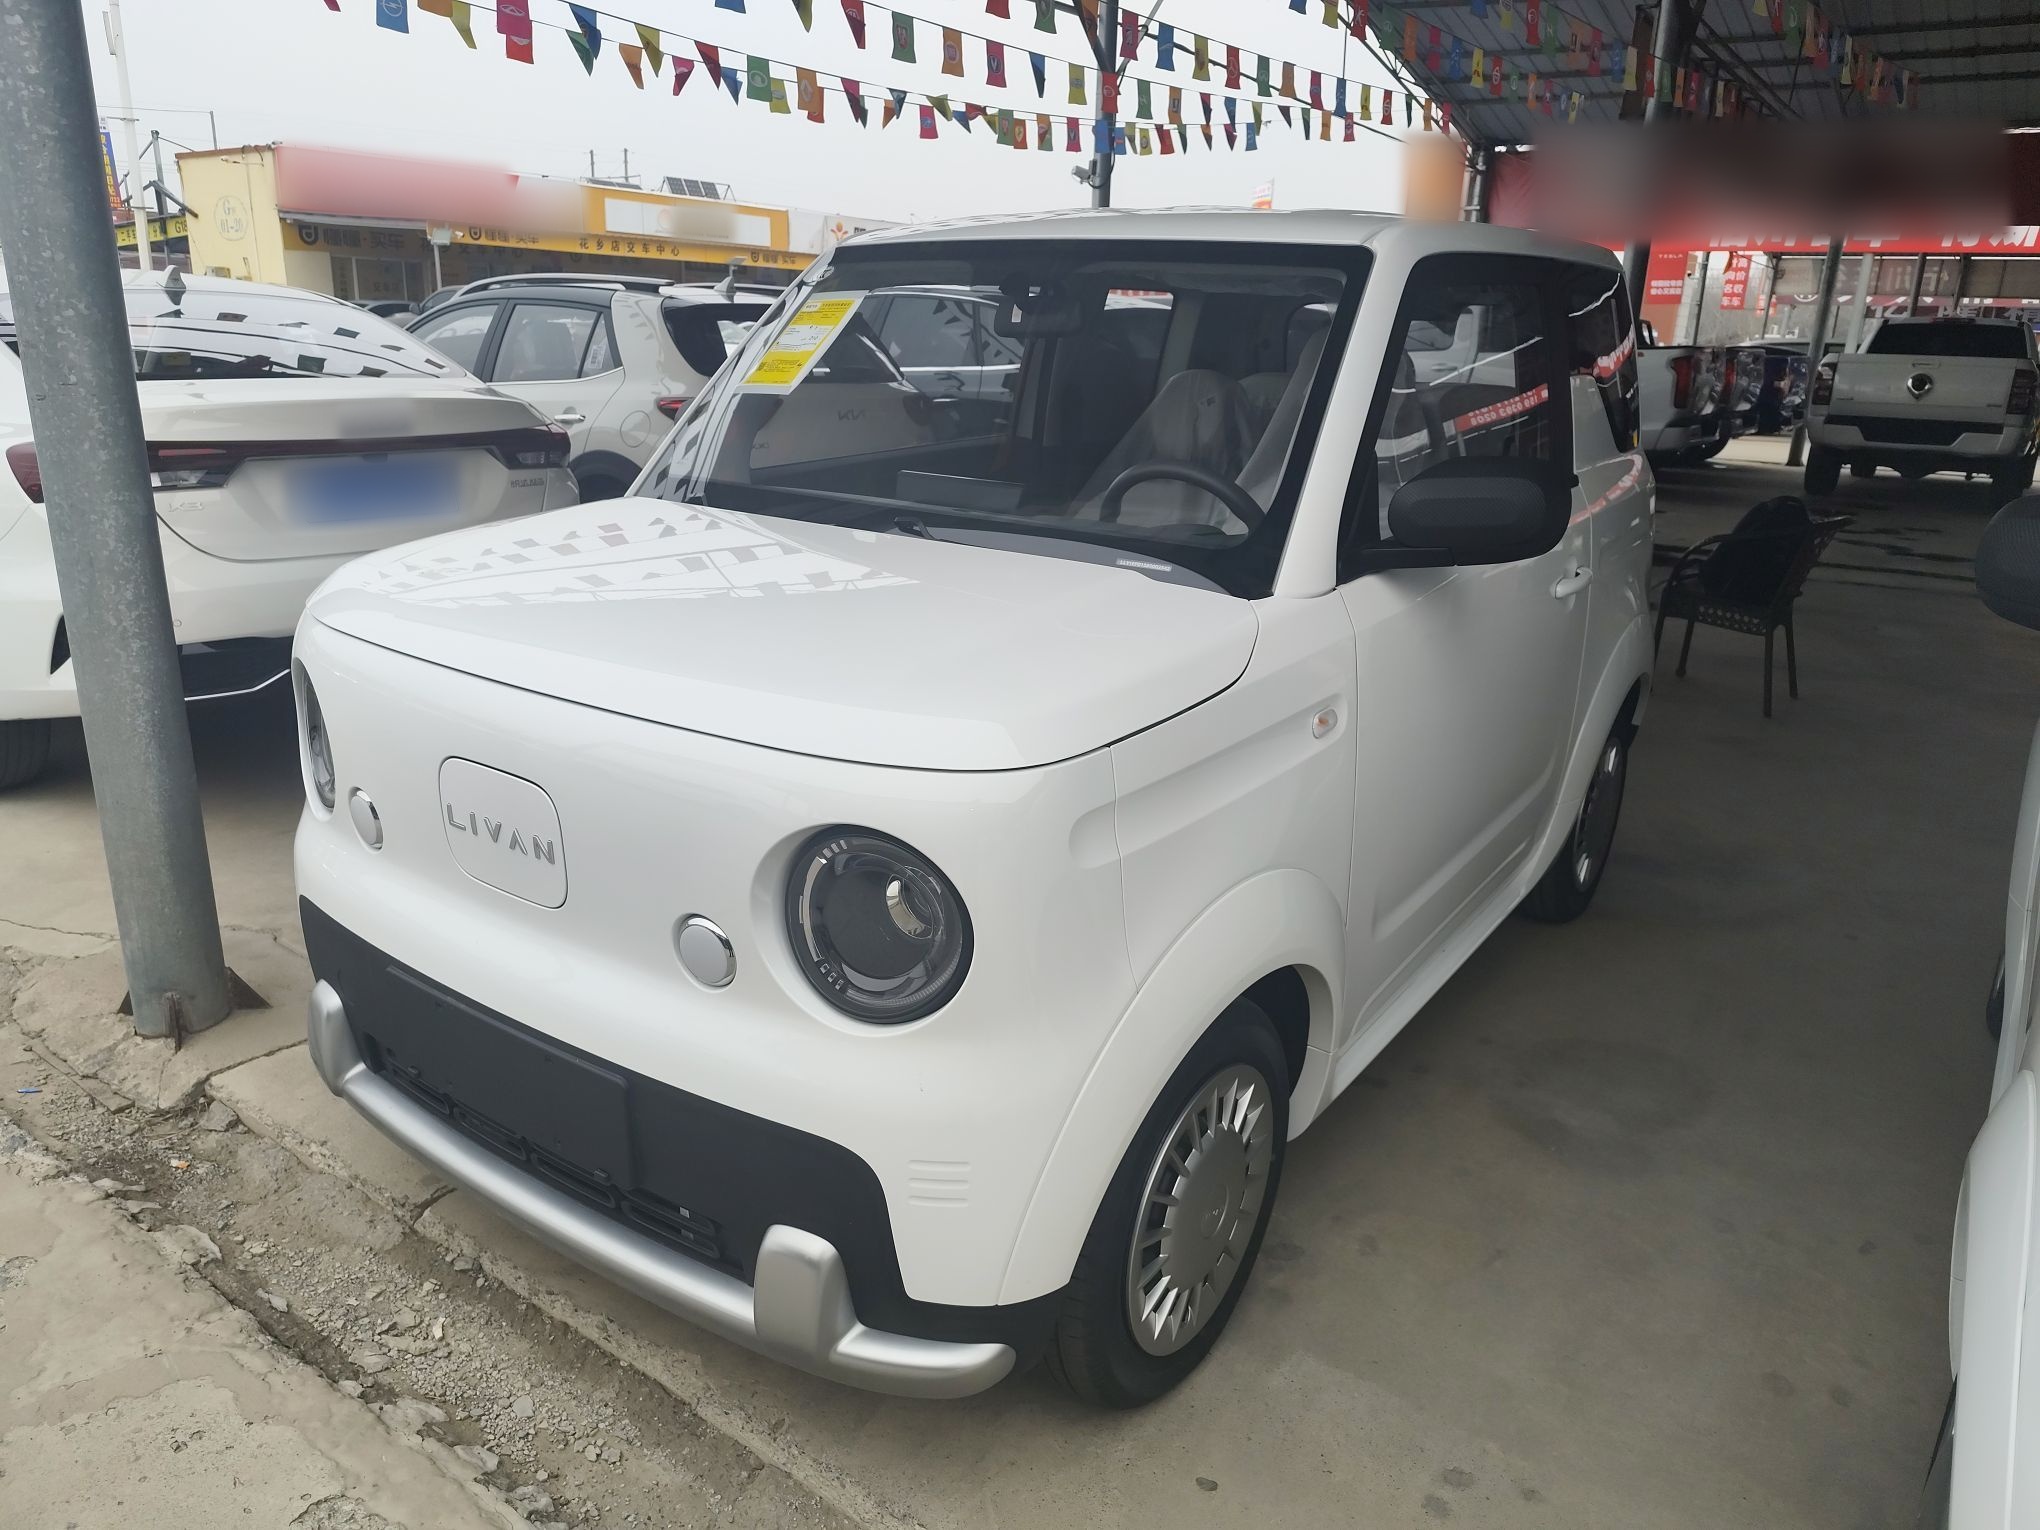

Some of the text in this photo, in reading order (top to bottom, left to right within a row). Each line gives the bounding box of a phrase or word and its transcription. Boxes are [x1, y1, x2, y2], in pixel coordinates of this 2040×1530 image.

[578, 236, 681, 257] 花乡店交车中心
[446, 802, 556, 865] LIVAN
